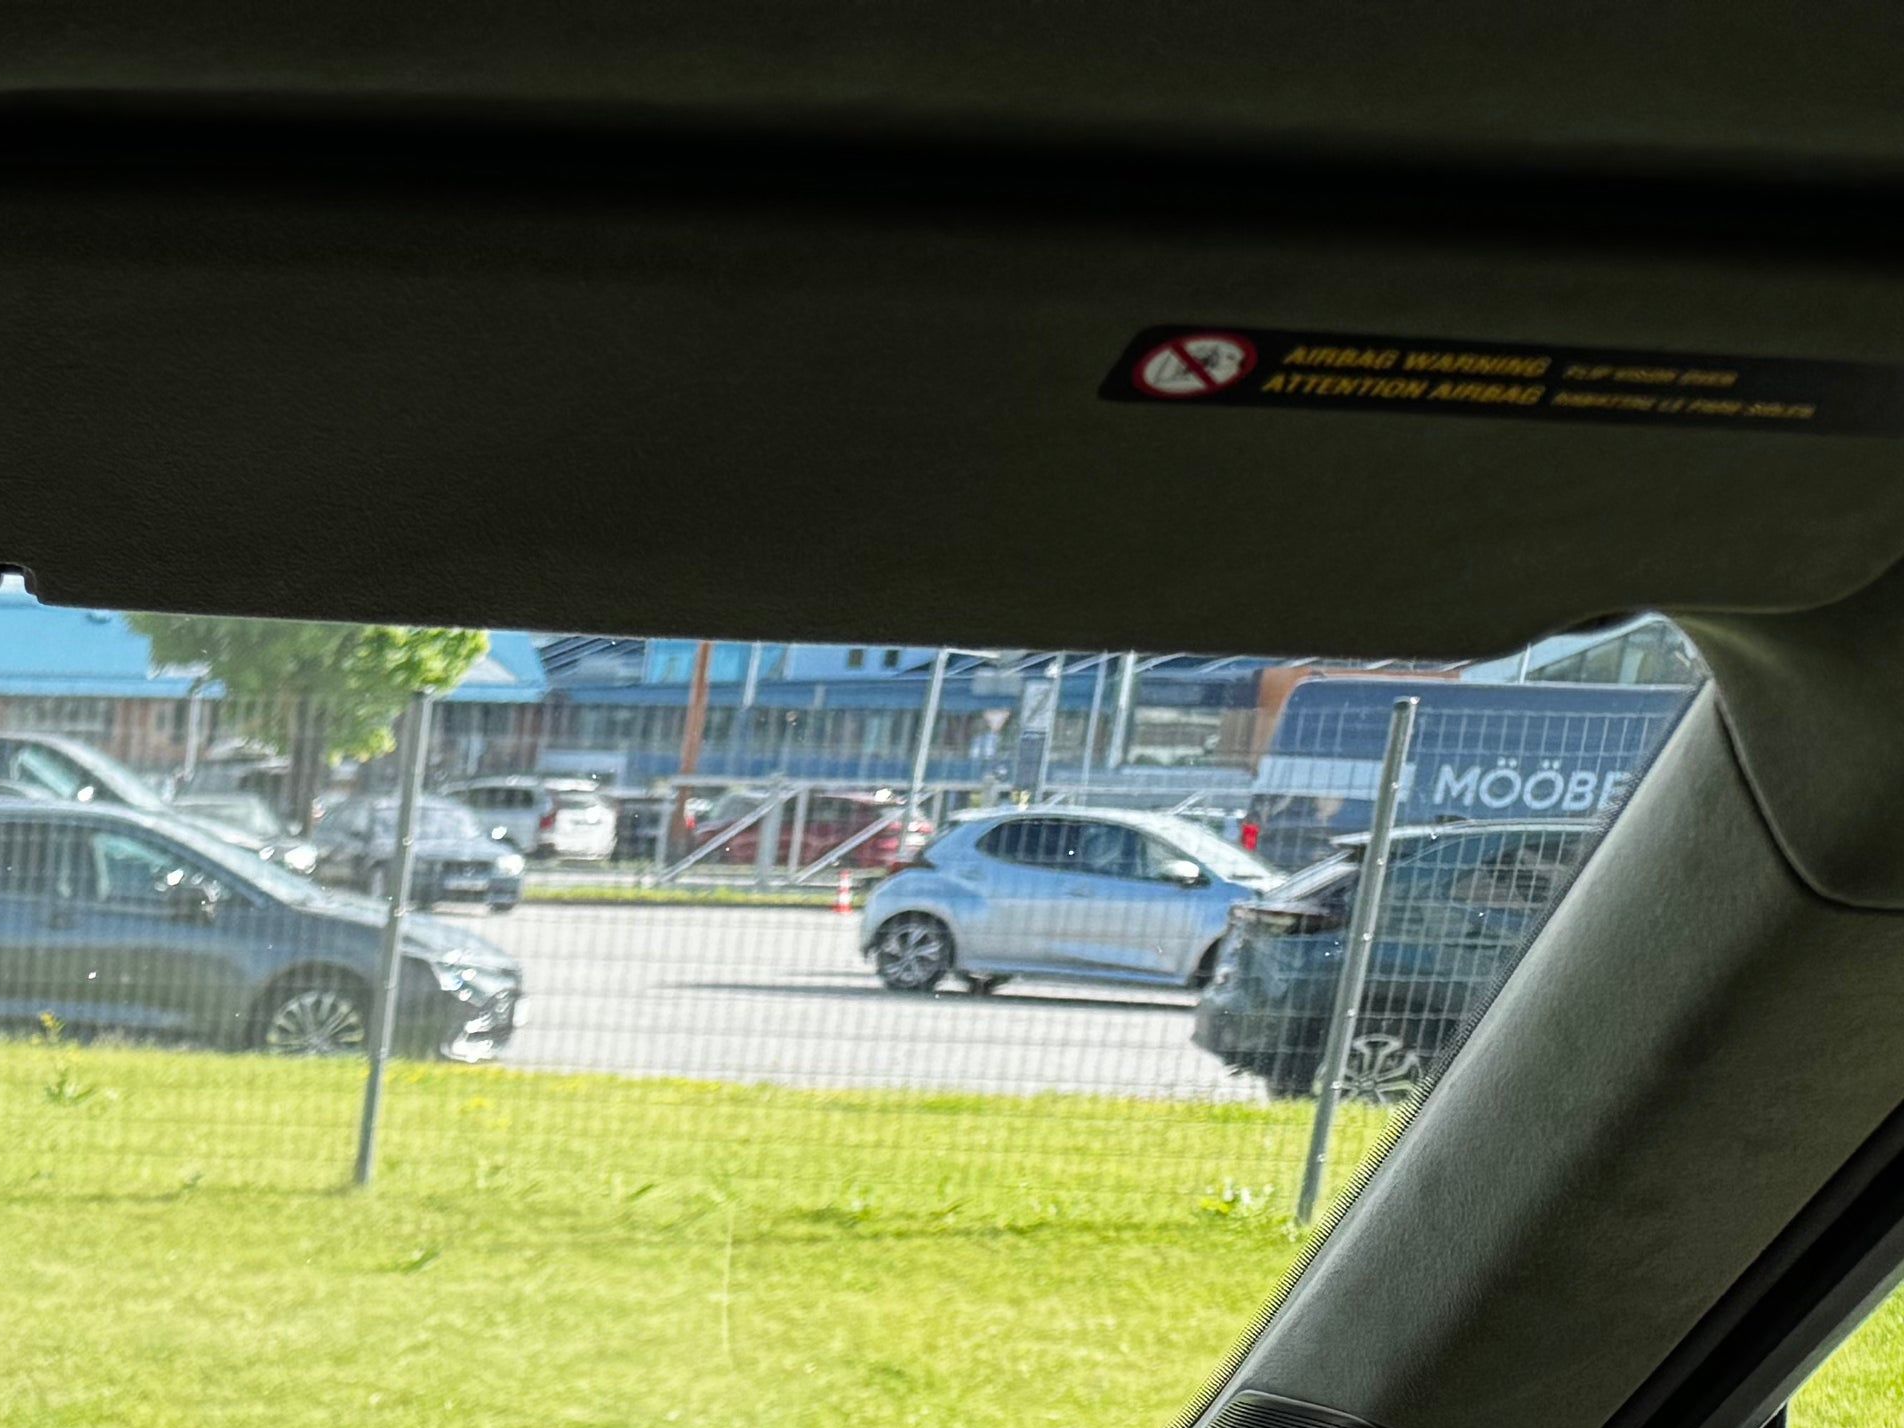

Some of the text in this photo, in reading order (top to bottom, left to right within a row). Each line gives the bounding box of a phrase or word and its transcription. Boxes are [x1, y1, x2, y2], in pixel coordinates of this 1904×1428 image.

[1283, 345, 1400, 370] AIRBAG
[1403, 351, 1552, 377] WARNING
[1261, 373, 1428, 398] ATTENTION
[1427, 381, 1546, 405] AIRBAG
